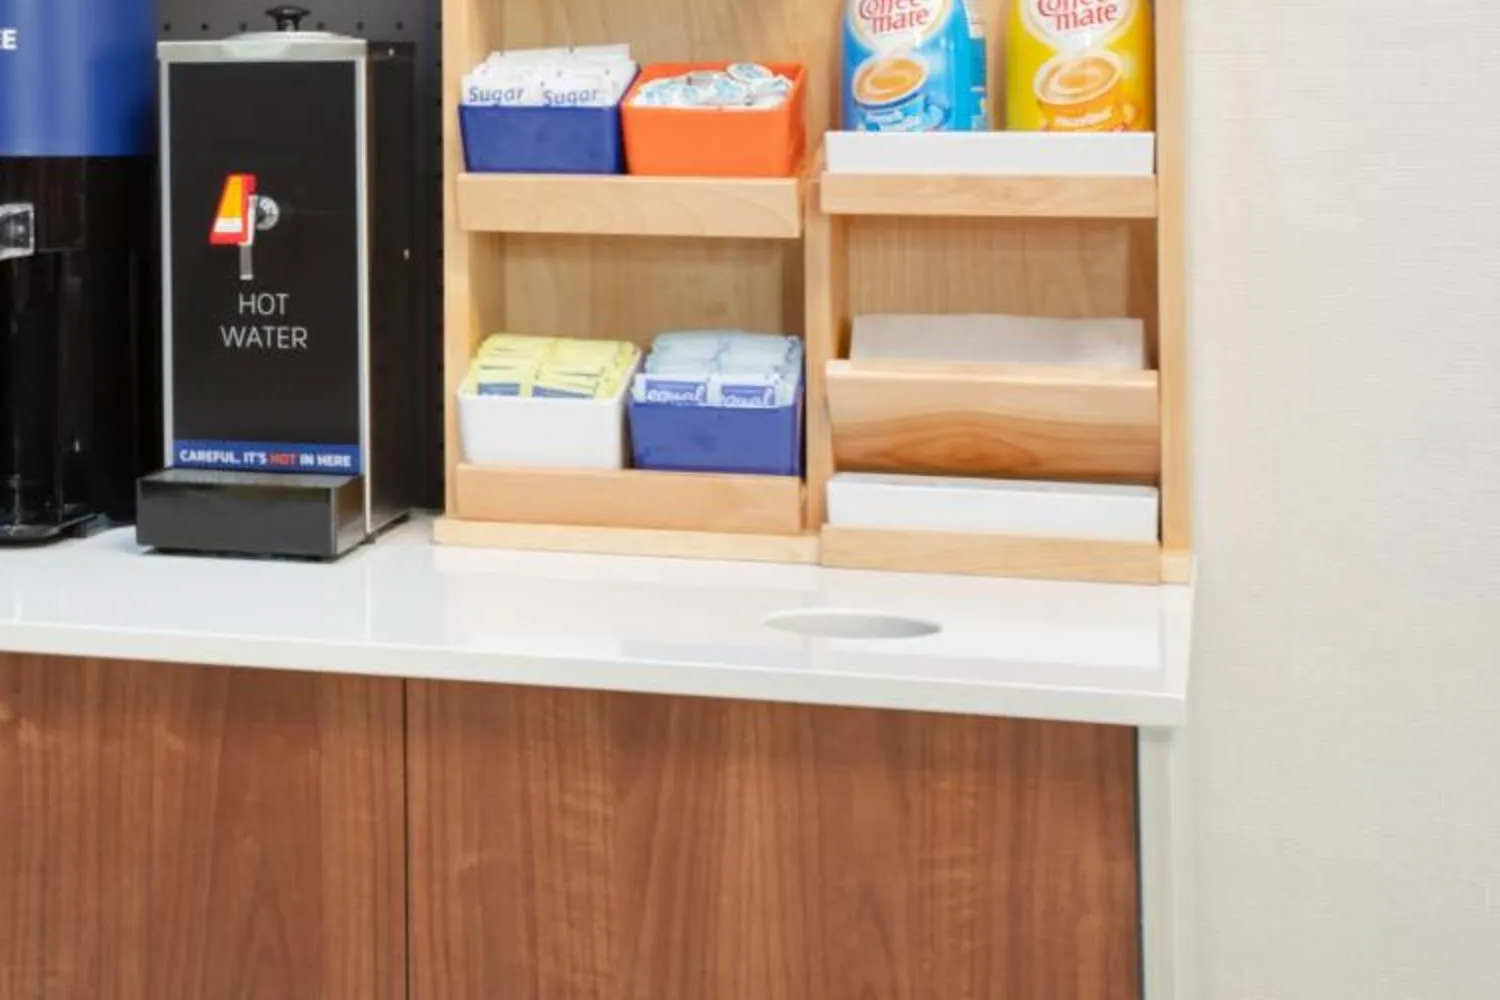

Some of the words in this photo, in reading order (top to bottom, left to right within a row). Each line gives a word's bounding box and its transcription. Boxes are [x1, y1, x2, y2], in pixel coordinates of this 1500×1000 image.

[872, 7, 929, 33] mate
[1056, 3, 1117, 31] mate
[469, 86, 524, 104] Sugar
[542, 87, 598, 106] Sugar
[238, 293, 290, 315] HOT
[220, 325, 309, 349] WATER
[243, 451, 268, 464] IT'S
[270, 452, 296, 466] HOT
[299, 453, 314, 466] IN
[317, 454, 352, 468] HERE
